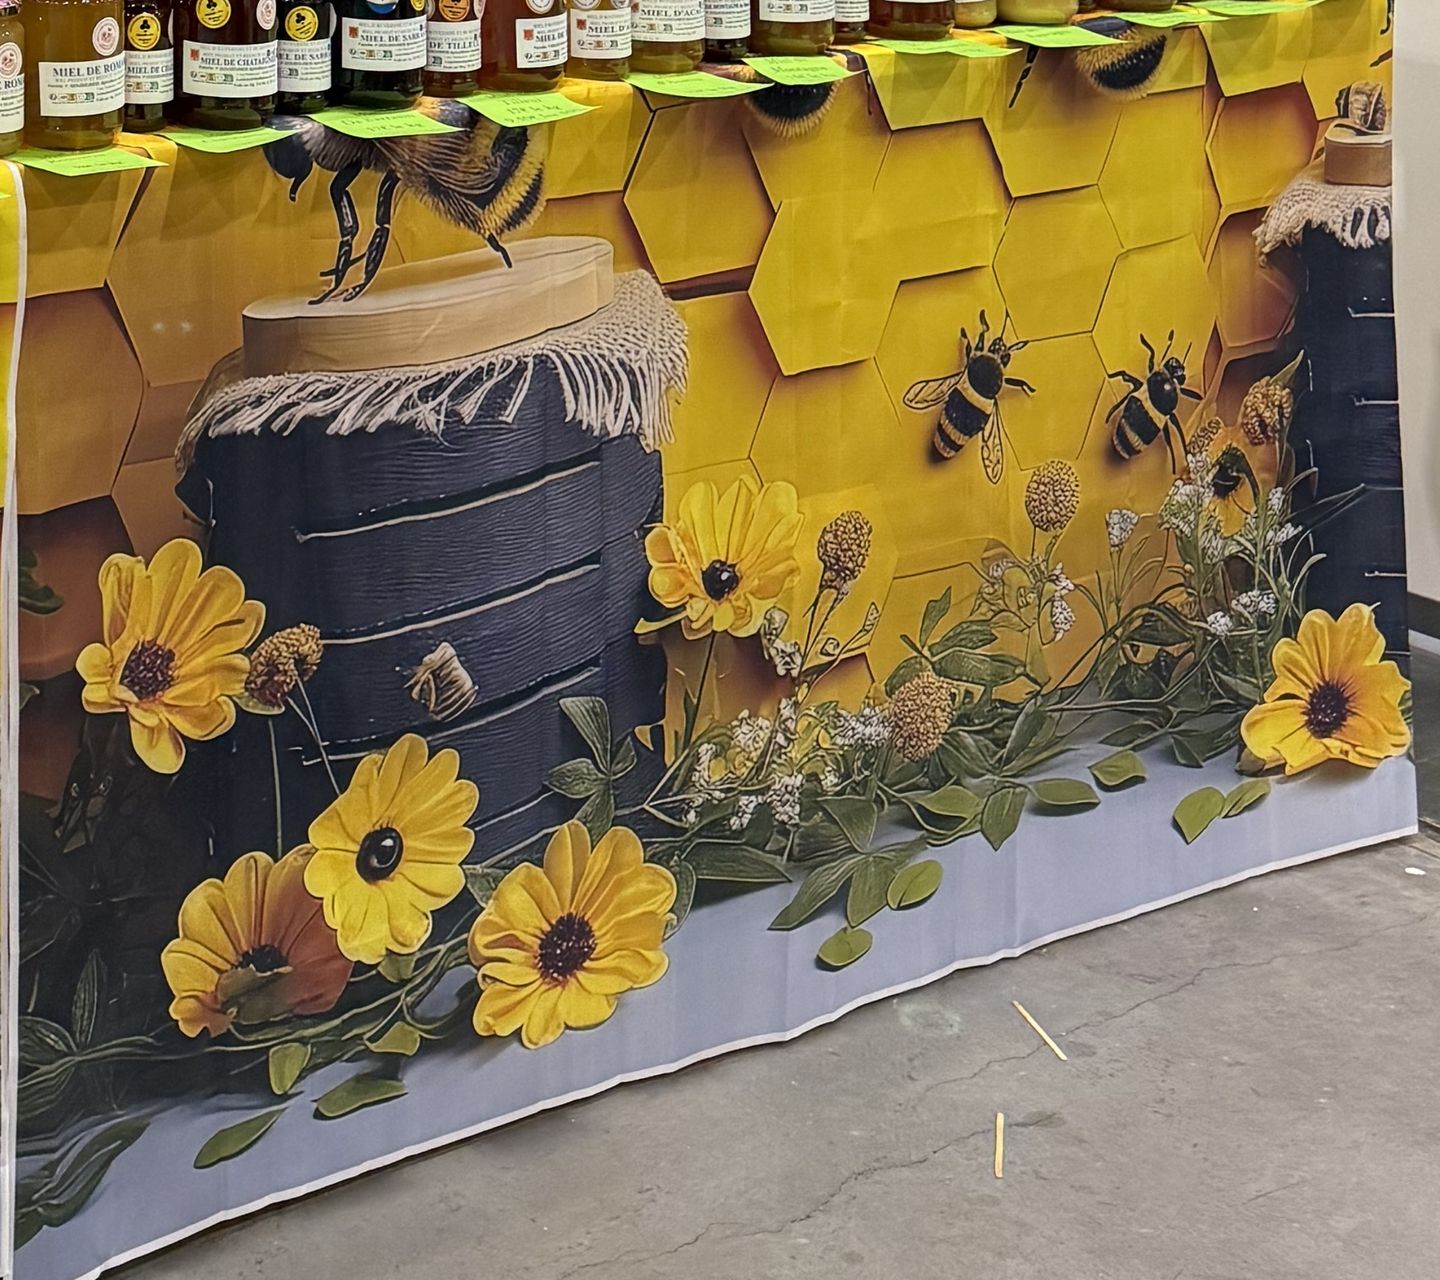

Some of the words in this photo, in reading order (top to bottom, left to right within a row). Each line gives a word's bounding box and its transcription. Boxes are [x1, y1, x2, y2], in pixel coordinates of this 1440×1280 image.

[641, 9, 671, 17] MIEL
[361, 34, 384, 42] MIEL
[388, 34, 401, 42] DE
[200, 57, 223, 65] MIEL
[224, 58, 234, 66] DE
[52, 67, 83, 77] MIEL
[86, 65, 101, 75] DE
